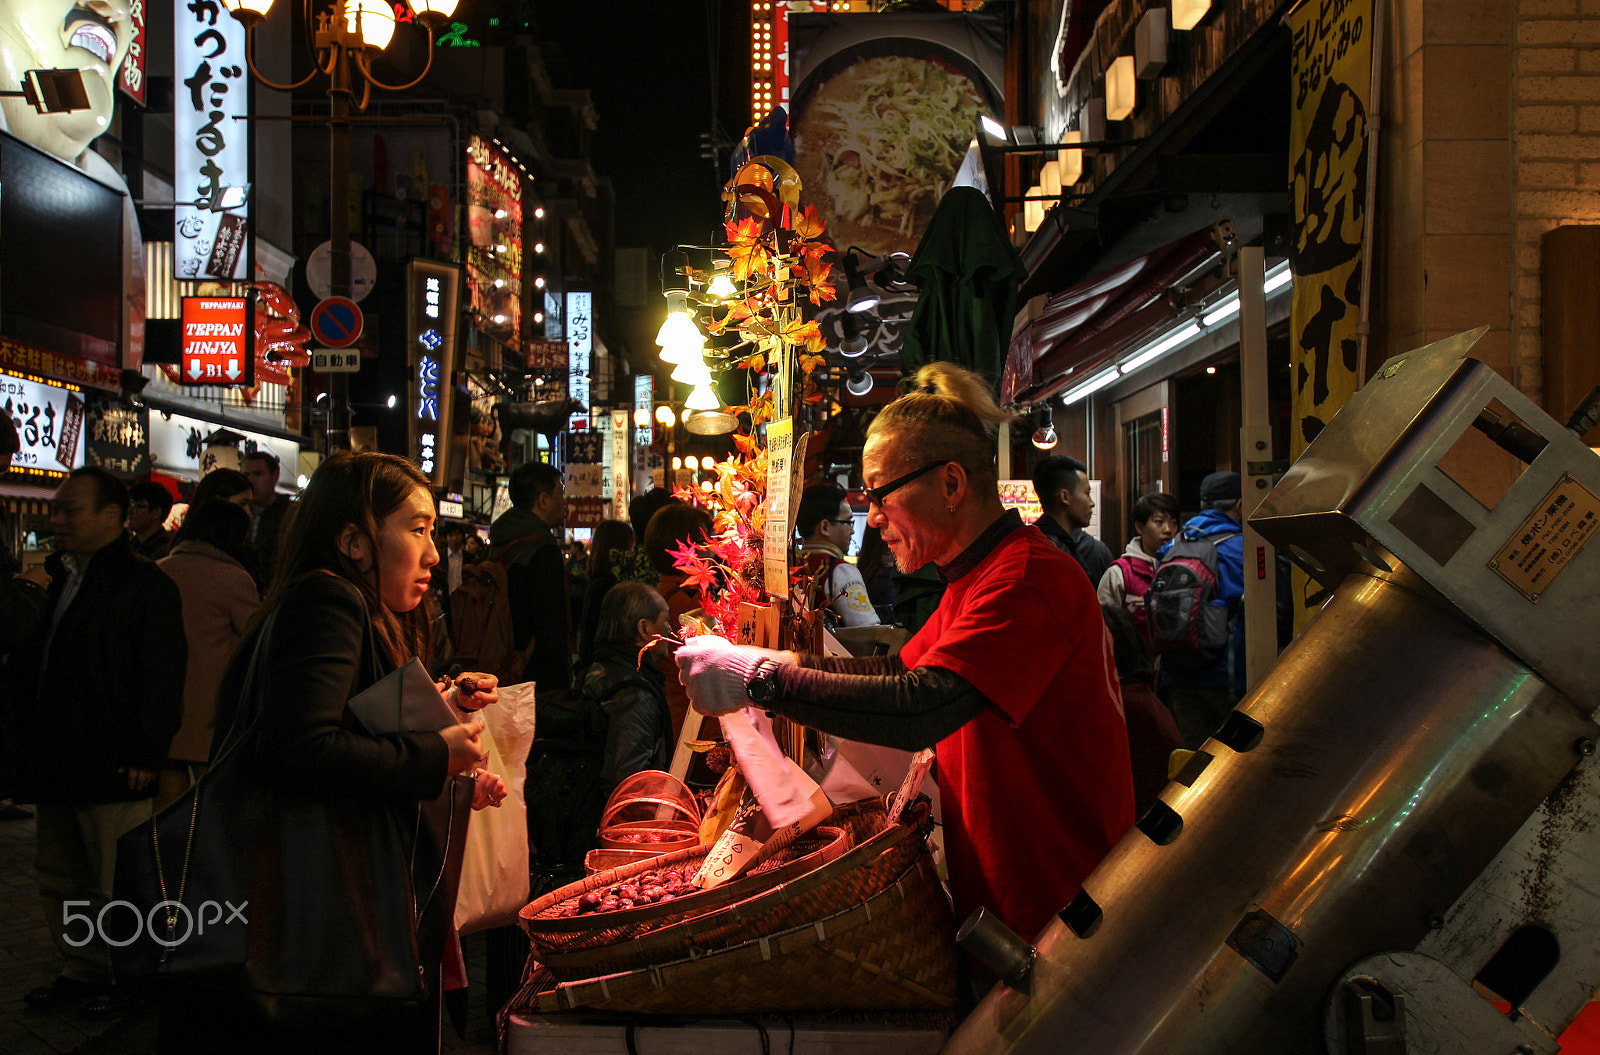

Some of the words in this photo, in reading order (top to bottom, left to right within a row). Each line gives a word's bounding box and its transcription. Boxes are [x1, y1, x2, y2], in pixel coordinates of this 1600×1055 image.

[1296, 15, 1363, 110] おなじみの
[200, 301, 244, 310] TEPPANYAKI
[186, 323, 244, 337] TEPPAN
[185, 341, 238, 355] JINJYA
[0, 340, 121, 388] 不法駐輪はやめましょう
[315, 354, 358, 367] 自動車
[206, 363, 223, 377] B1
